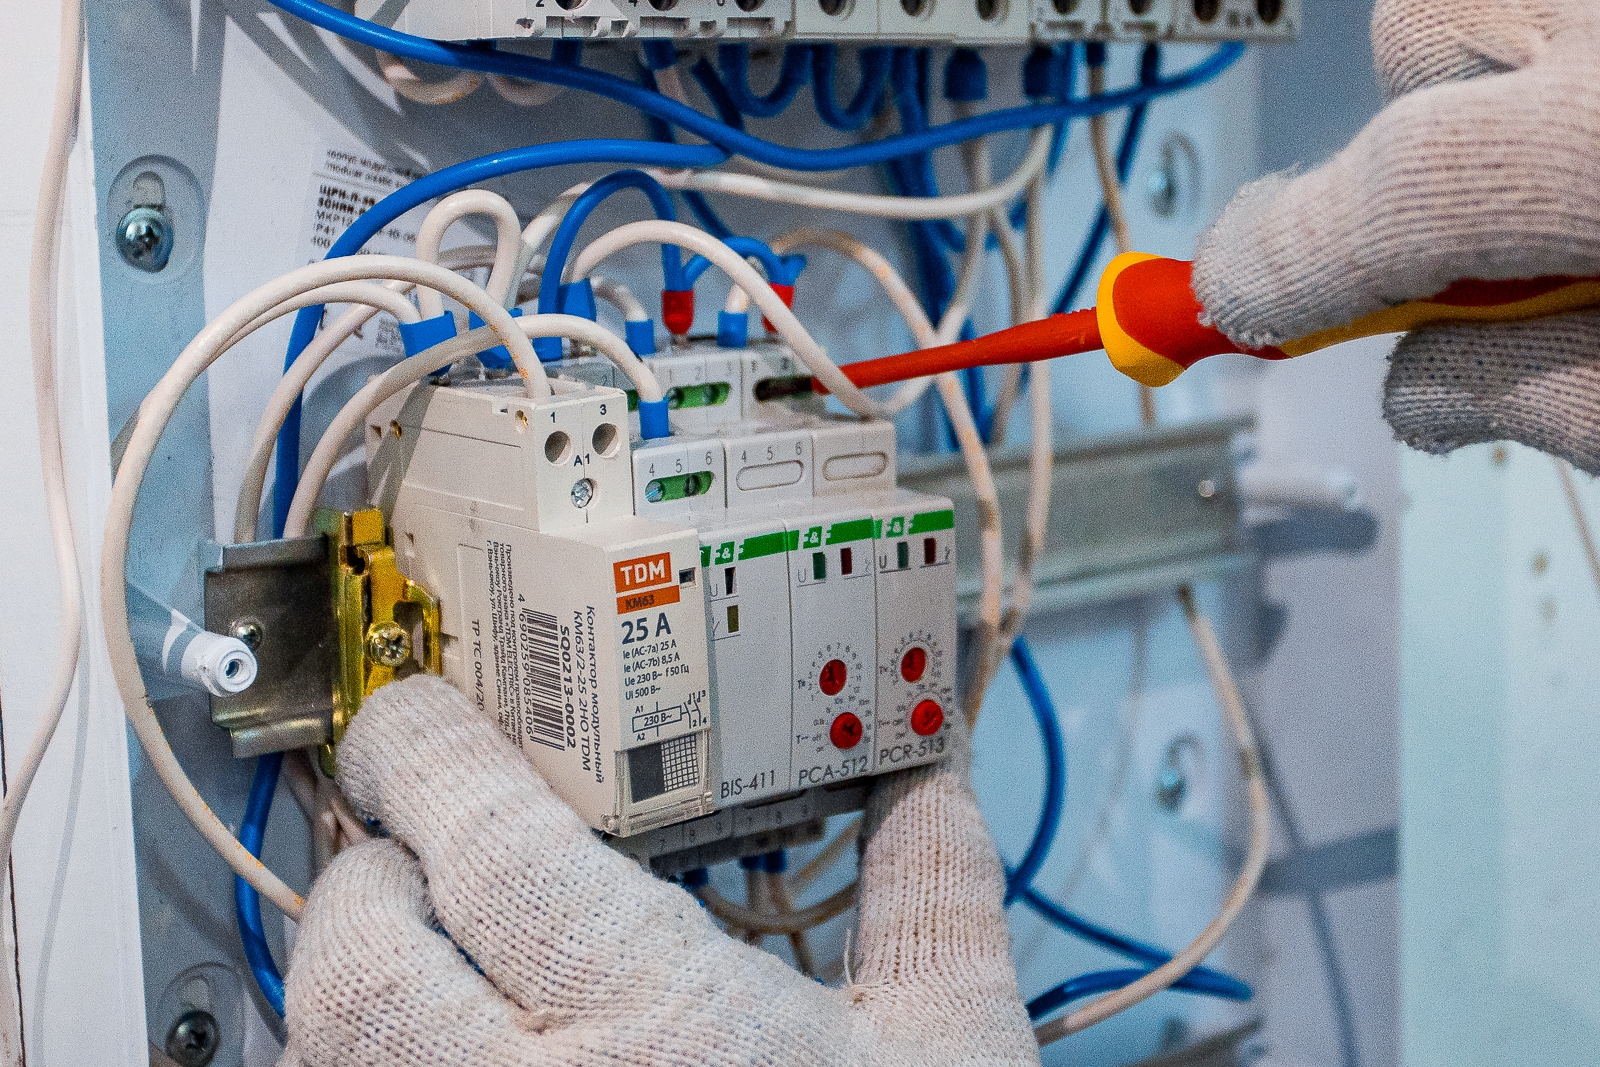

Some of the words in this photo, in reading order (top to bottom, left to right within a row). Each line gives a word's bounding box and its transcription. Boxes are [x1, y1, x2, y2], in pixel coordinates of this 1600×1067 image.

[550, 411, 556, 424] 1
[600, 403, 607, 416] 3
[574, 453, 591, 467] A1
[649, 463, 655, 477] 4
[675, 459, 683, 474] 5
[705, 451, 713, 465] 6
[741, 450, 747, 463] 4
[766, 447, 774, 460] 5
[795, 441, 803, 455] 6
[620, 559, 666, 586] TDM
[518, 594, 526, 603] 4
[518, 613, 530, 672] 690259
[621, 617, 649, 645] 25
[511, 629, 519, 681] контролем
[586, 605, 598, 690] Контактор
[631, 643, 659, 659] (AC-7a)
[660, 641, 670, 652] 25
[624, 677, 635, 687] Ue
[636, 673, 651, 684] 230
[670, 665, 680, 677] 50
[632, 656, 661, 673] (AC-7b)
[560, 624, 576, 749] SQ0213-0002
[635, 687, 650, 698] 500
[702, 689, 706, 698] 3
[522, 677, 534, 736] 085406
[635, 705, 644, 714] A1
[643, 714, 659, 727] 230
[692, 719, 697, 727] 2
[591, 693, 605, 784] модульный
[636, 732, 646, 742] A2
[580, 735, 591, 772] TDM
[878, 737, 946, 766] PCR-513
[798, 756, 869, 785] PCA-512
[720, 769, 776, 799] BIS-411
